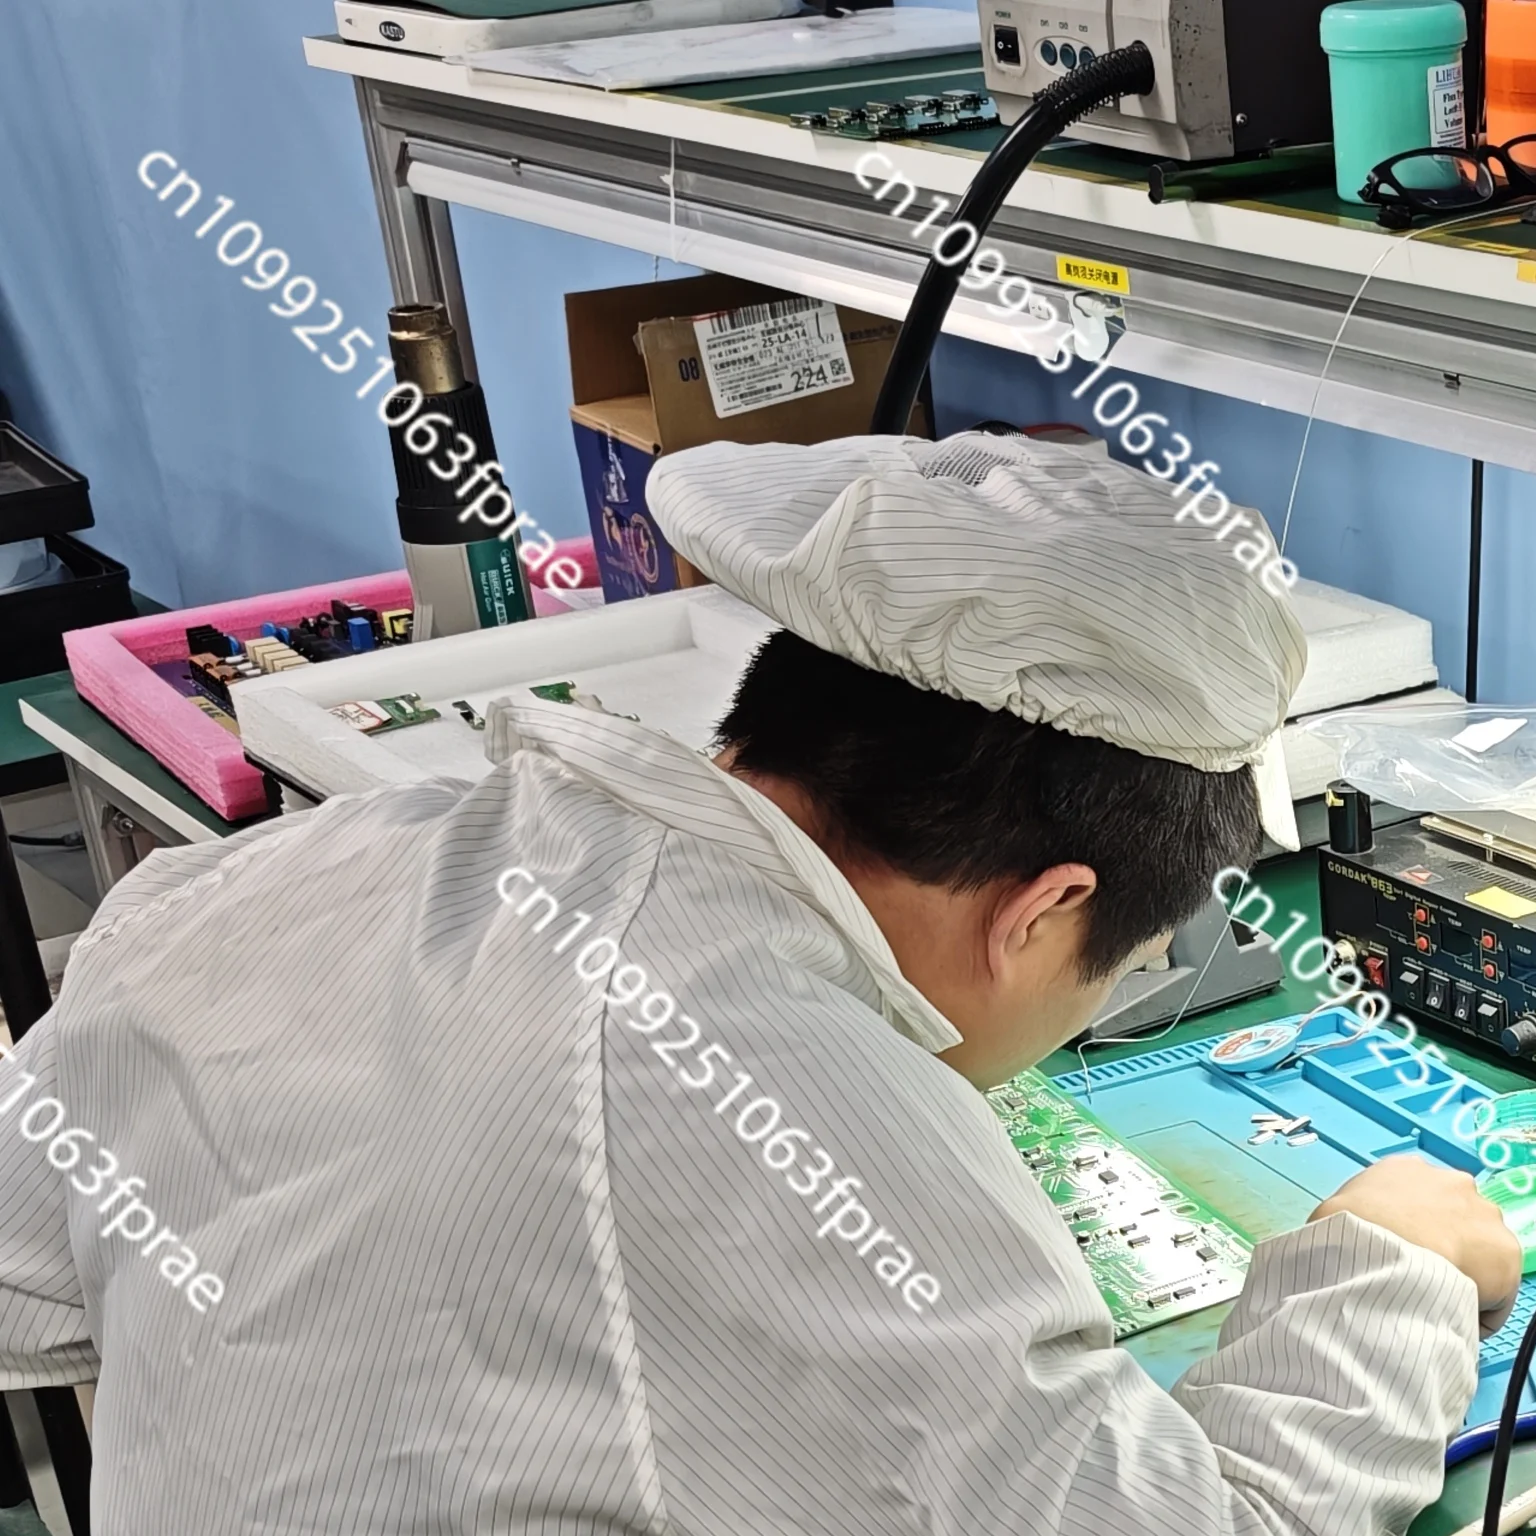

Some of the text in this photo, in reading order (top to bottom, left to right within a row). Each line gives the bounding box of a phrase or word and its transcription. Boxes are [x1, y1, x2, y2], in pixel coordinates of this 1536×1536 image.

[761, 327, 808, 348] 25-LA-14
[790, 364, 829, 393] 224
[1327, 861, 1368, 885] GORDAK
[1370, 877, 1394, 894] 863
